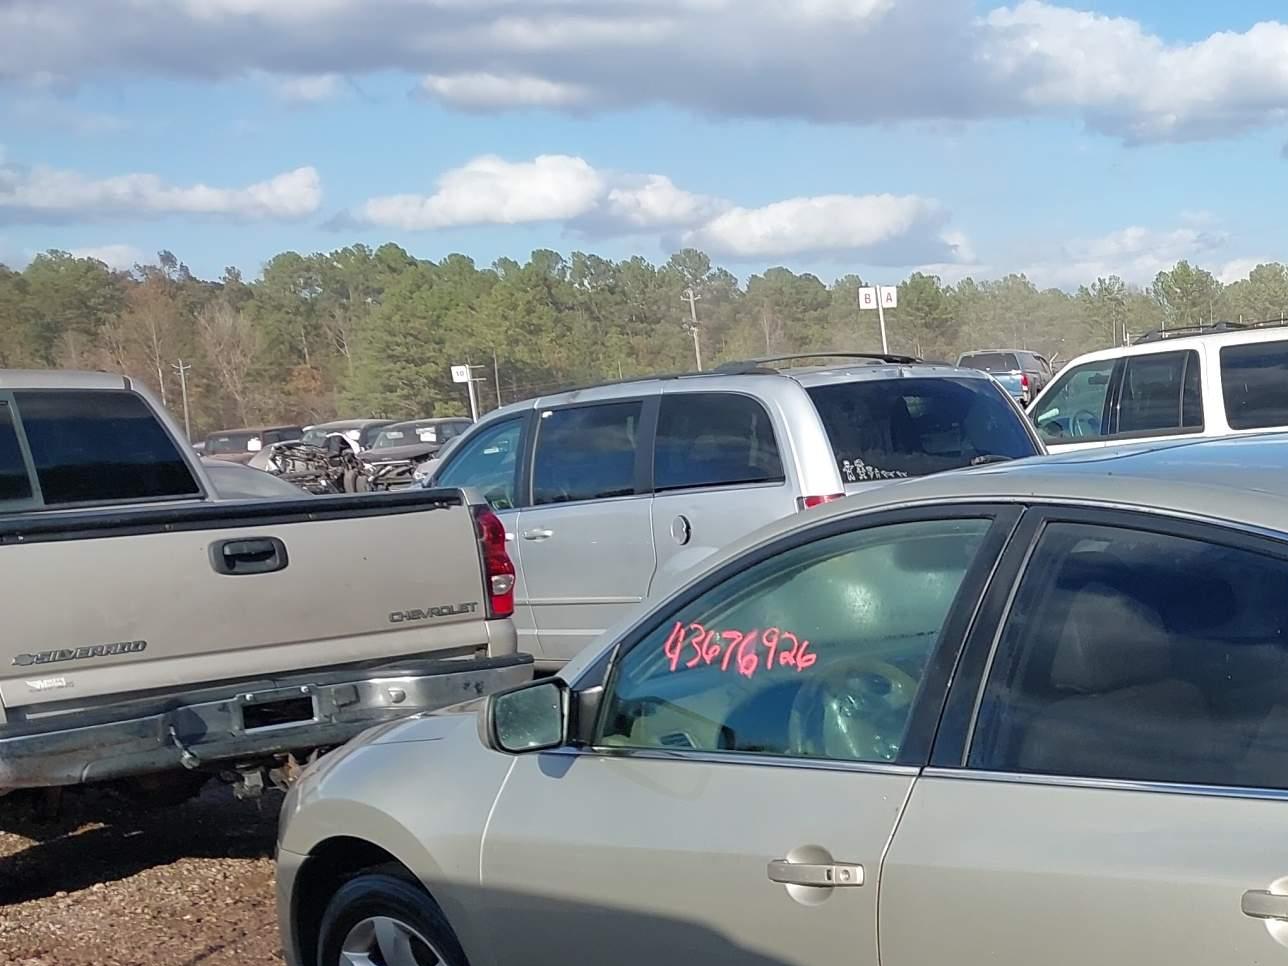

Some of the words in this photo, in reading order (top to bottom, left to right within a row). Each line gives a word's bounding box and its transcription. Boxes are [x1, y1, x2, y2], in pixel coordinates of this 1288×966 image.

[864, 293, 872, 304] B
[886, 292, 893, 303] A
[389, 602, 478, 623] CHEVROLET
[34, 640, 147, 665] SILVERADO
[664, 621, 817, 679] 43676926
